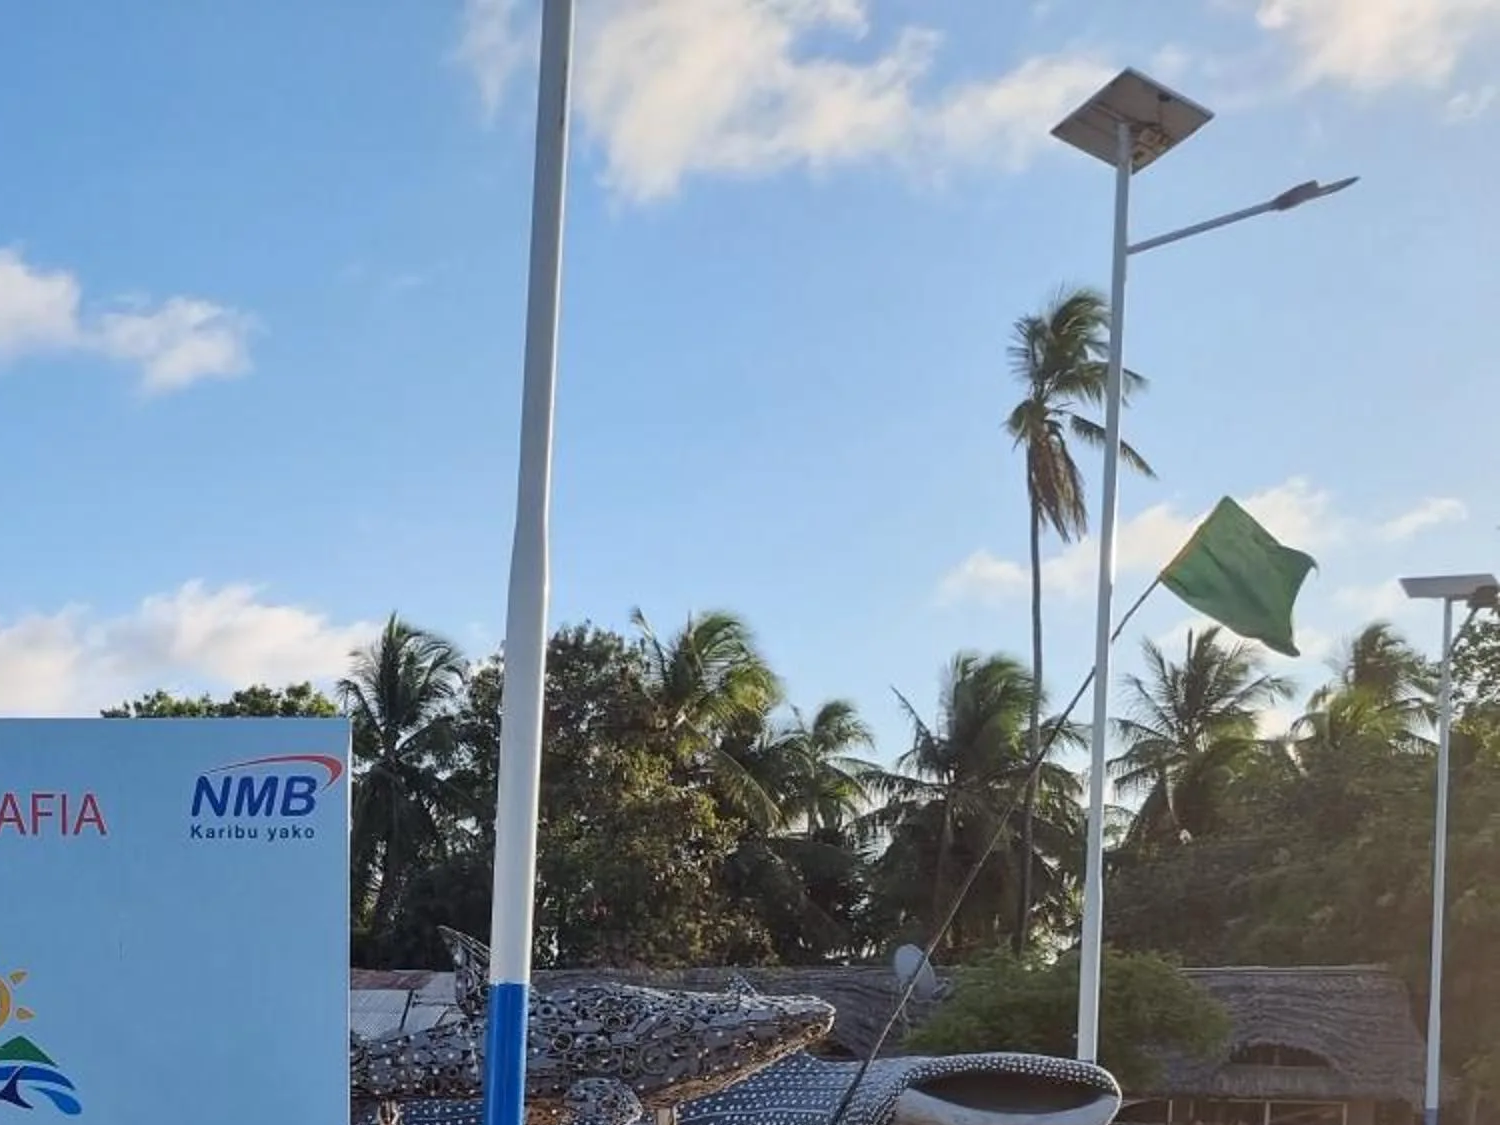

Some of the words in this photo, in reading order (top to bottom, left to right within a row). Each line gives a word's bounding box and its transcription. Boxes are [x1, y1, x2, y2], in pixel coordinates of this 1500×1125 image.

[191, 775, 317, 816] NMB
[190, 825, 257, 839] Karibu
[267, 825, 315, 842] yako
